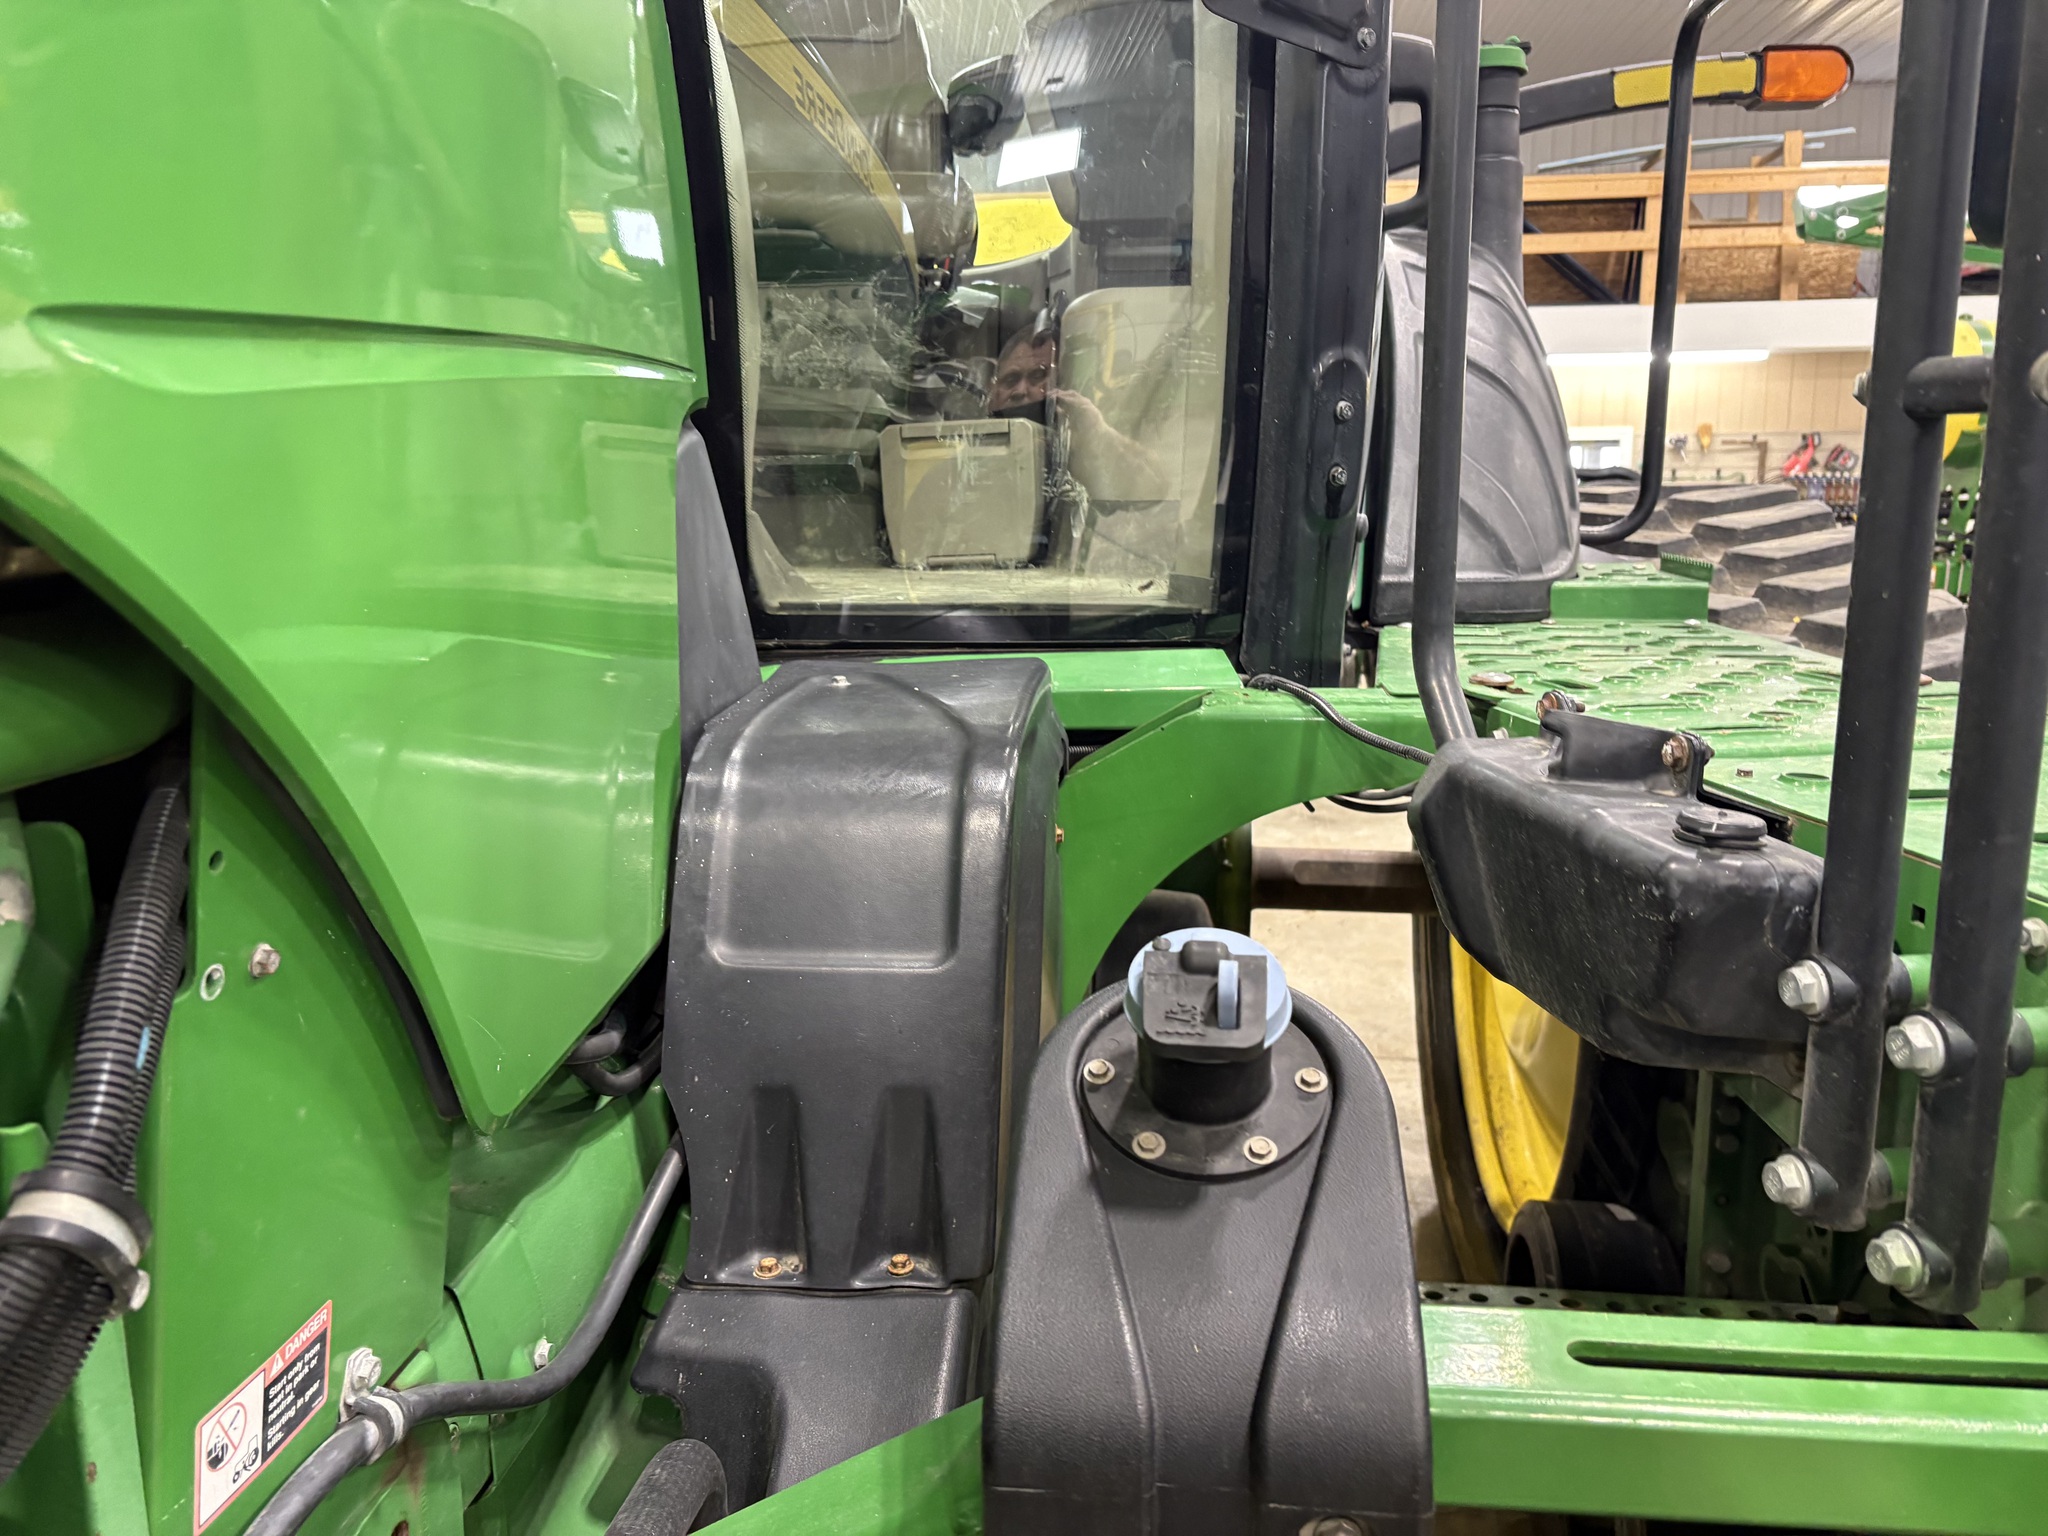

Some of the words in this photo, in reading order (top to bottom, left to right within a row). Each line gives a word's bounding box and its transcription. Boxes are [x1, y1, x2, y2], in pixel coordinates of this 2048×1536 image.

[285, 1309, 328, 1360] DANGER
[268, 1389, 285, 1412] seat
[285, 1381, 293, 1397] in
[293, 1364, 310, 1387] park
[310, 1356, 319, 1369] or
[269, 1375, 287, 1398] Start
[287, 1359, 304, 1379] only
[304, 1343, 321, 1362] from
[267, 1407, 296, 1439] Starting
[296, 1397, 304, 1408] in
[304, 1379, 321, 1400] gear
[268, 1394, 296, 1424] neutral.
[267, 1432, 285, 1452] kills.
